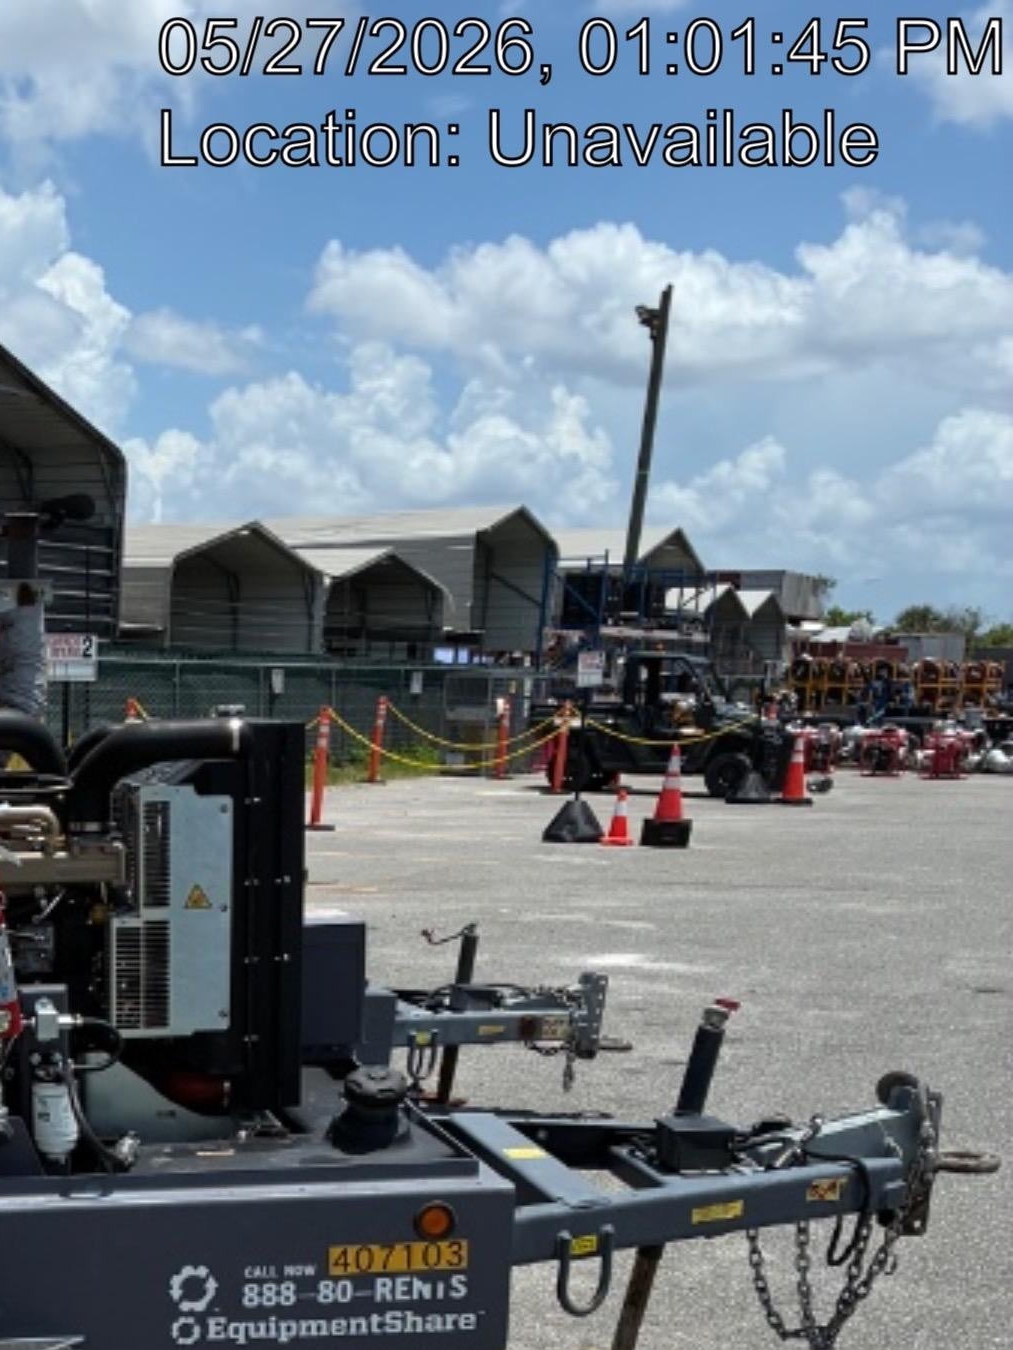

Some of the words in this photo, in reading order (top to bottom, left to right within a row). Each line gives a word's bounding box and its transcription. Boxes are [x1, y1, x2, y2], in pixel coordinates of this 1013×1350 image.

[82, 635, 94, 657] 2
[331, 1240, 467, 1273] 407103
[284, 1264, 317, 1277] NOW
[206, 1310, 477, 1344] EquipmentShare
